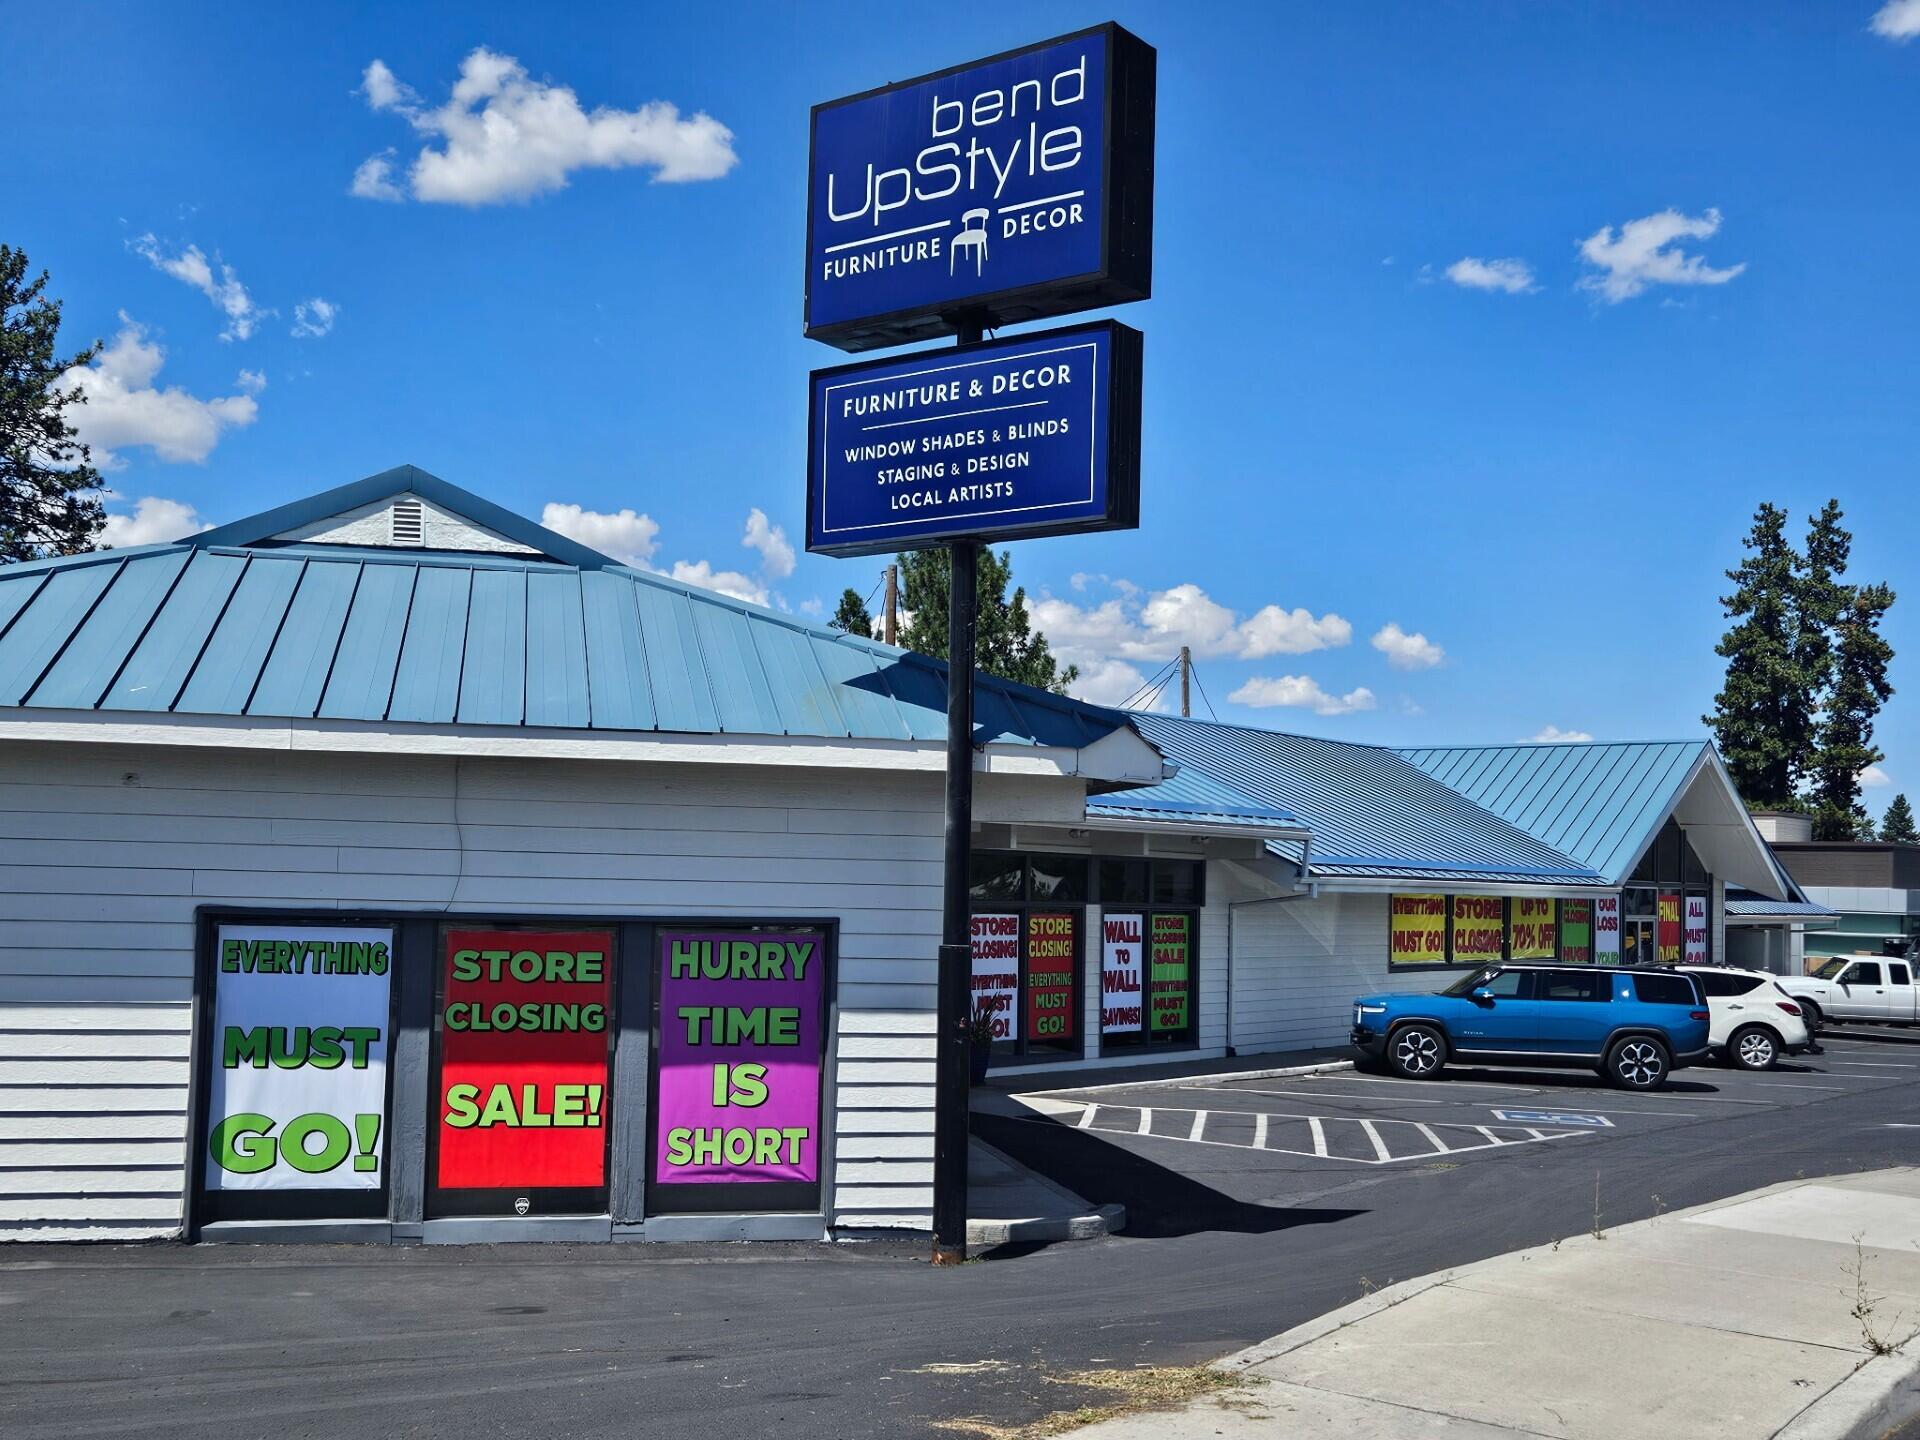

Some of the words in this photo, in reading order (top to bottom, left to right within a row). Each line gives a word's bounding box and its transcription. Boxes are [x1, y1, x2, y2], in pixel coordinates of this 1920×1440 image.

[932, 55, 1086, 139] bend
[827, 121, 1083, 226] UpStyle
[823, 237, 941, 281] FURNITURE
[1003, 203, 1084, 238] DECOR
[843, 381, 960, 418] FURNITURE
[968, 379, 983, 397] &
[992, 364, 1071, 395] DECOR
[845, 439, 916, 463] WINDOW
[922, 429, 985, 452] SHADES
[992, 430, 1001, 443] &
[1008, 417, 1069, 440] BLINDS
[877, 462, 944, 485] STAGING
[951, 463, 960, 476] &
[967, 451, 1029, 473] DESIGN
[891, 490, 942, 510] LOCAL
[948, 481, 1013, 503] ARTISTS
[1455, 898, 1501, 919] STORE
[1520, 898, 1533, 916] UP
[1535, 899, 1548, 916] TO
[1598, 898, 1616, 912] OUR
[1659, 901, 1680, 922] FINAL
[1689, 902, 1704, 917] ALL
[971, 917, 1018, 936] STORE
[1029, 918, 1072, 935] STORE
[1103, 921, 1141, 943] WALL
[1597, 916, 1618, 931] LOSS
[1393, 930, 1423, 952] MUST
[1425, 930, 1444, 952] GO!
[1455, 929, 1501, 953] CLOSING
[1513, 923, 1535, 950] 70%
[1684, 928, 1706, 943] MUST
[221, 939, 389, 976] EVERYTHING
[971, 940, 1017, 959] CLOSING!
[1029, 940, 1072, 957] CLOSING!
[1115, 948, 1130, 965] TO
[1153, 948, 1184, 964] SALE
[1659, 946, 1680, 961] DAYS
[451, 950, 604, 984] STORE
[670, 940, 814, 981] HURRY
[1029, 973, 1072, 987] EVERYTHING
[1103, 970, 1140, 993] WALL
[1035, 993, 1067, 1009] MUST
[1153, 997, 1184, 1011] MUST
[444, 1002, 606, 1033] CLOSING
[678, 1006, 800, 1047] TIME
[1037, 1016, 1064, 1034] GO!
[1102, 1007, 1141, 1026] SAVINGS!
[988, 1018, 1010, 1038] O!
[222, 1026, 380, 1070] MUST
[712, 1063, 769, 1108] IS
[443, 1083, 604, 1129] SALE!
[209, 1112, 382, 1174] GO!
[666, 1127, 809, 1167] SHORT
